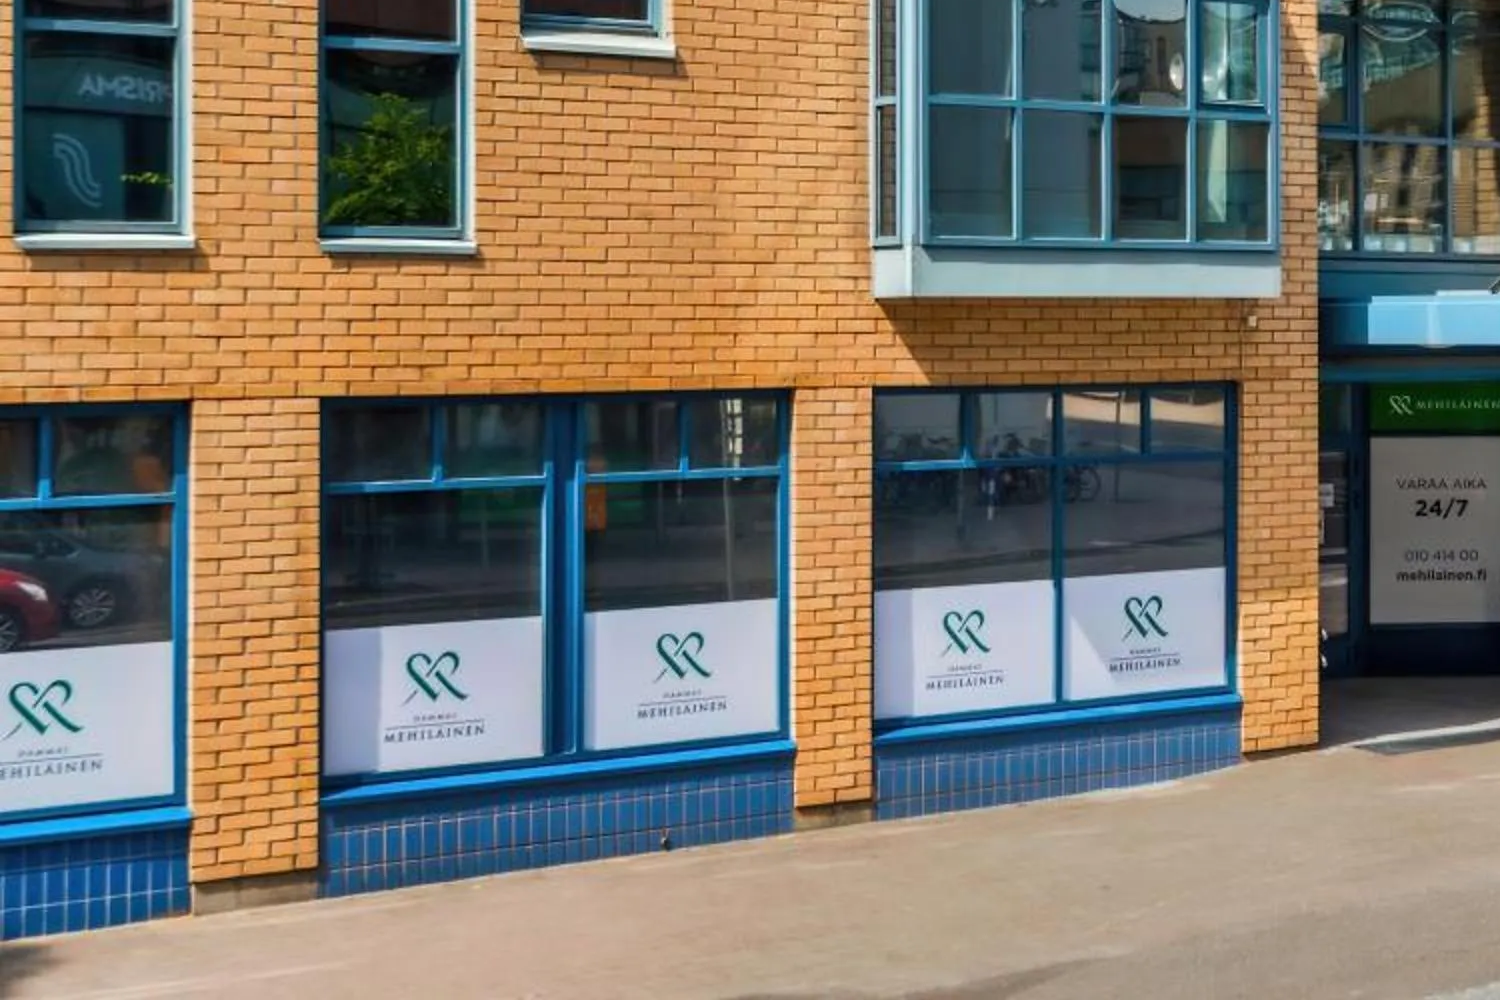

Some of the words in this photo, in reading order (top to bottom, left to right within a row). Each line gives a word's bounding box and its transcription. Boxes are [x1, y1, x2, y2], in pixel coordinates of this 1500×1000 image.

[1395, 477, 1448, 490] VARAA
[1453, 477, 1488, 489] AIKA
[1415, 498, 1468, 519] 24/7
[1404, 549, 1429, 562] 010
[1459, 548, 1479, 562] 00
[1396, 567, 1487, 582] mehilainen.fi
